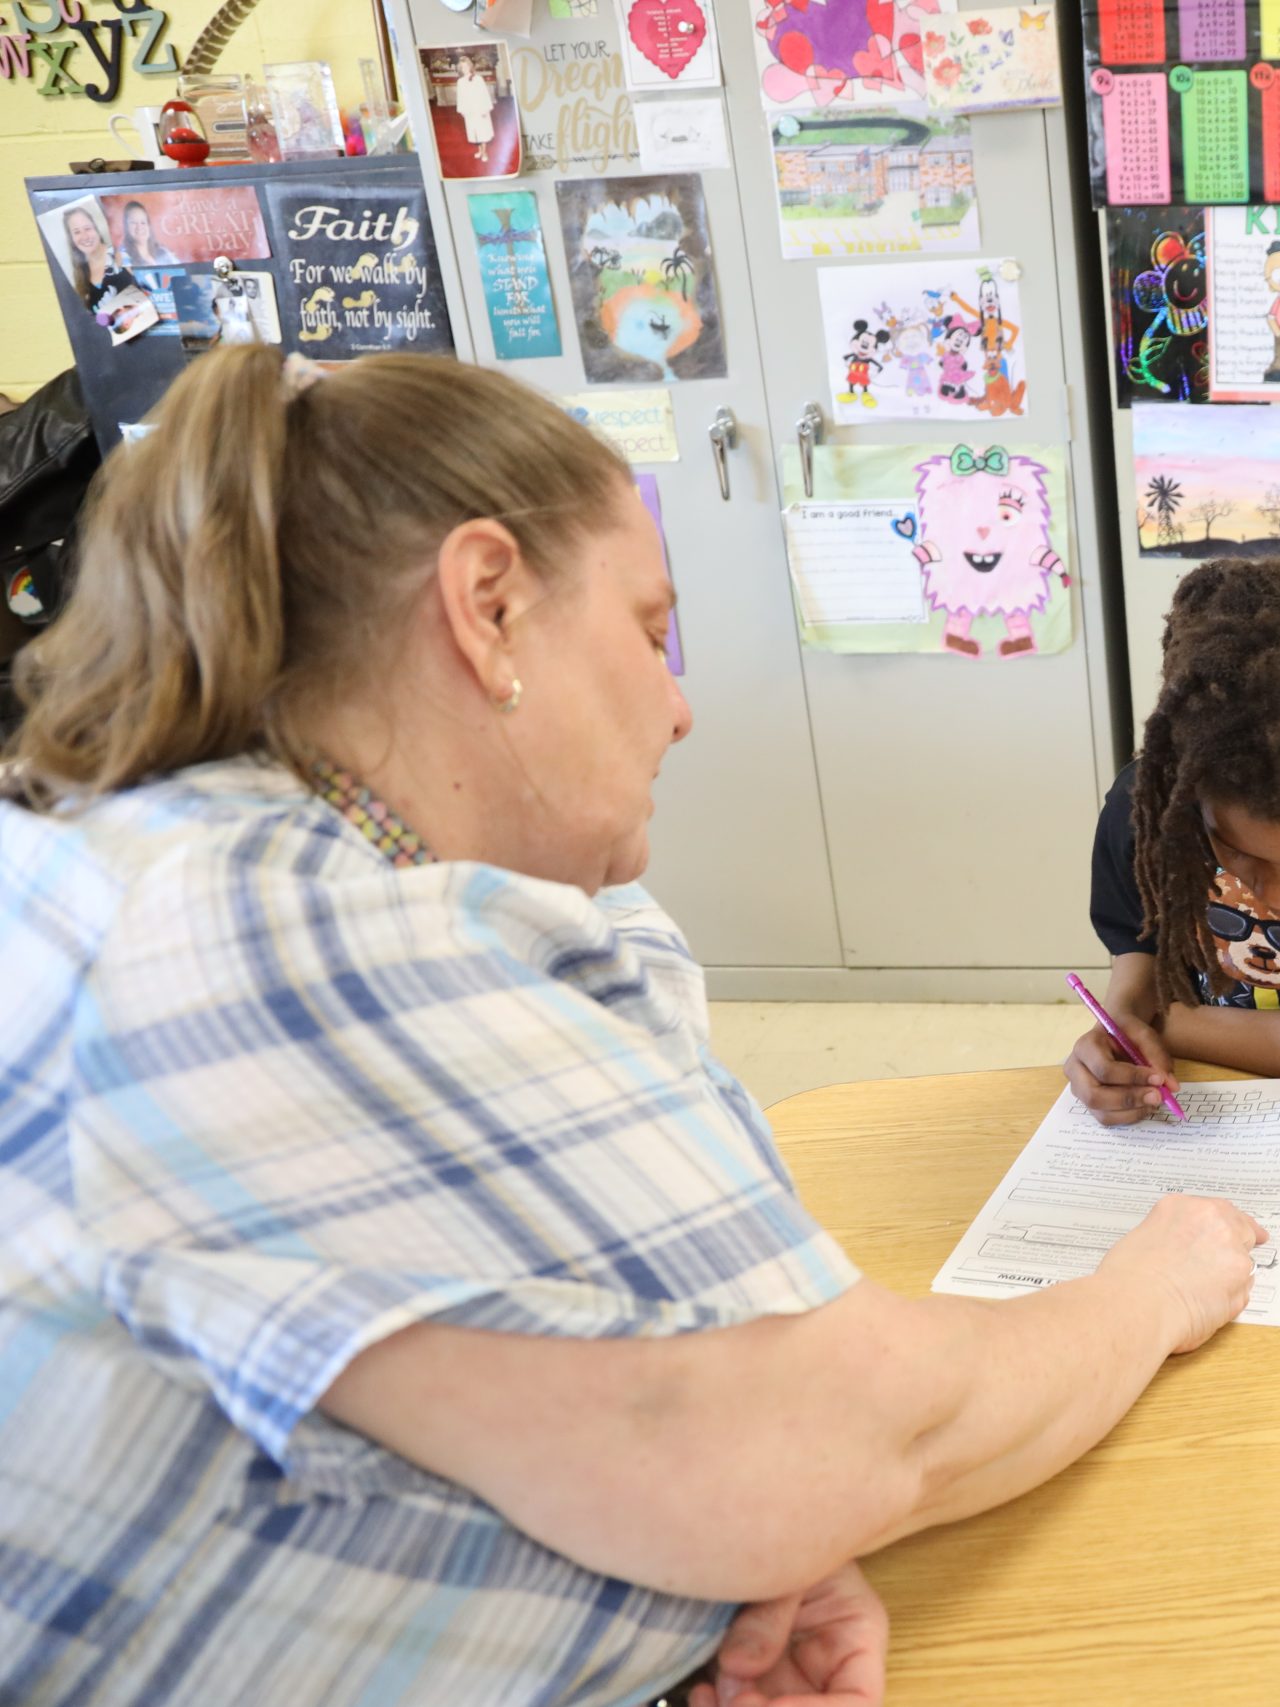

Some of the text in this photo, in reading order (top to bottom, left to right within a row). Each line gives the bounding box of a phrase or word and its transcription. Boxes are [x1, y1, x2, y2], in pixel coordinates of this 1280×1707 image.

[544, 41, 610, 62] LET YOUR
[160, 210, 253, 236] GREAT
[288, 206, 420, 251] Faith
[289, 259, 325, 284] For
[329, 265, 354, 284] we
[493, 275, 538, 292] STAND
[345, 306, 370, 329] not
[373, 298, 392, 341] by
[396, 299, 436, 341] sight.
[838, 510, 861, 519] good
[995, 1273, 1043, 1284] Burrow
